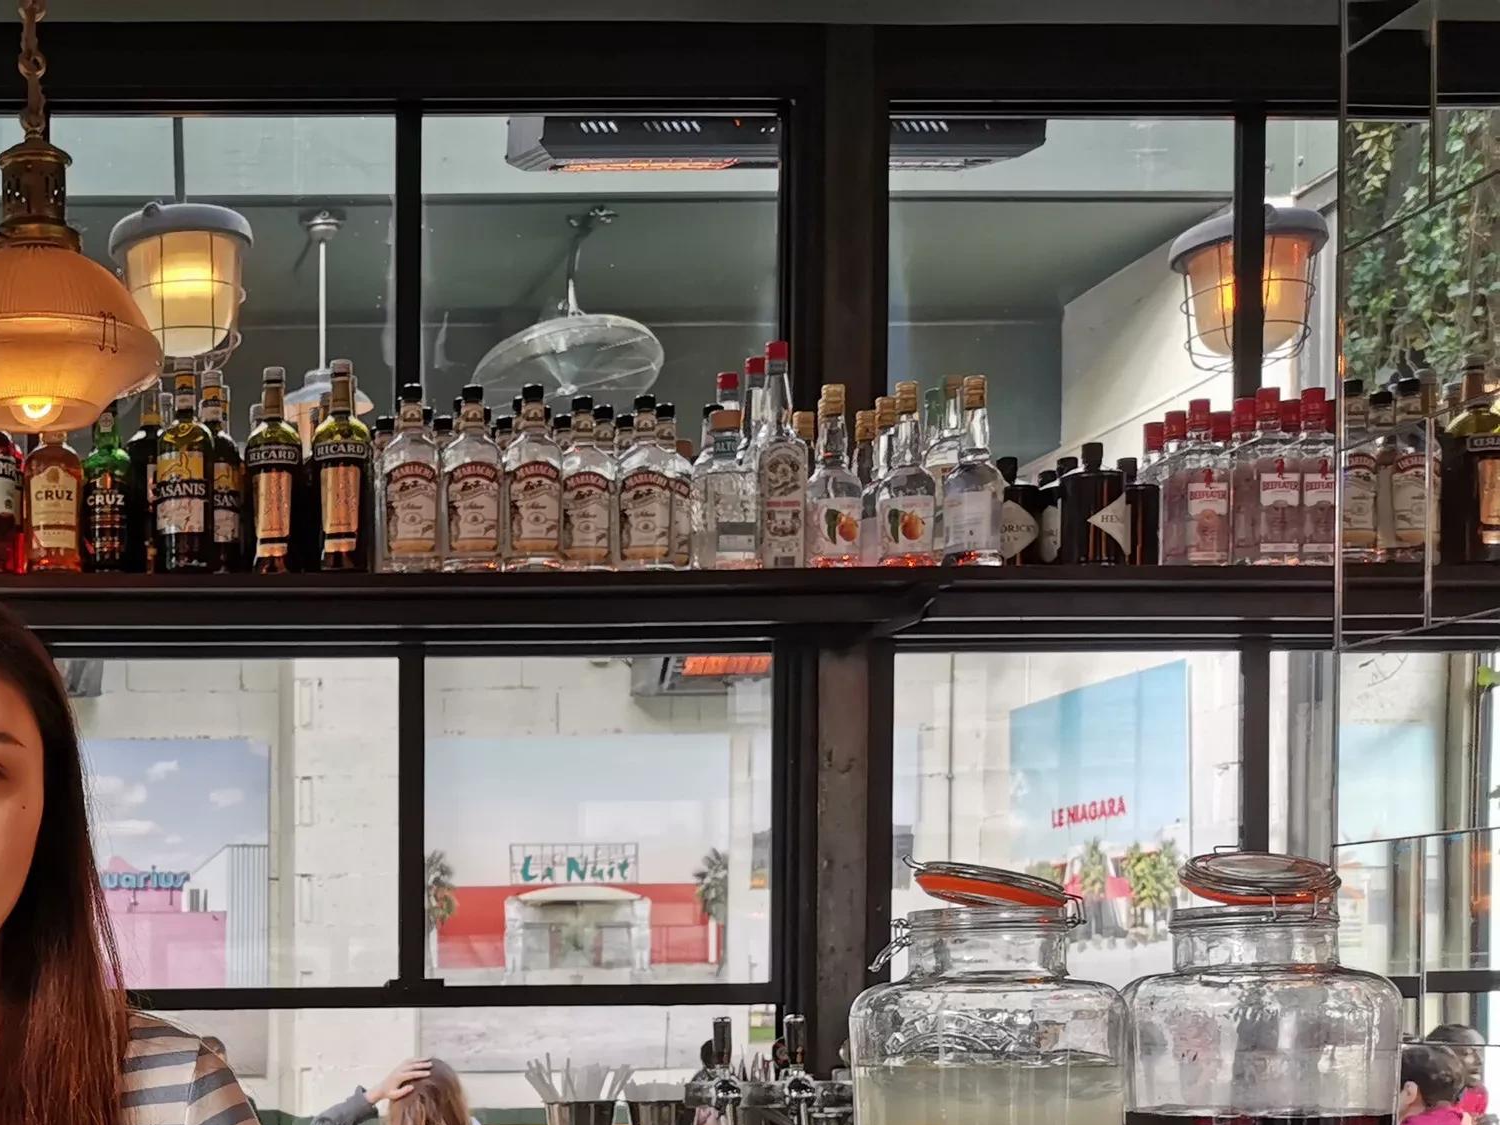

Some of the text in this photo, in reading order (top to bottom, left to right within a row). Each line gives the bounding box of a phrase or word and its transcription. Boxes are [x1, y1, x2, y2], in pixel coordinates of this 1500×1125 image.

[249, 449, 297, 462] RICARD
[316, 443, 365, 456] RICARD
[1262, 480, 1300, 492] BEEFEATER
[35, 490, 73, 501] CRUZ
[86, 494, 125, 506] CRUZ
[1189, 490, 1228, 501] BEEFEATER
[1052, 795, 1126, 828] LE NIAGARA
[520, 855, 630, 882] La Nuit
